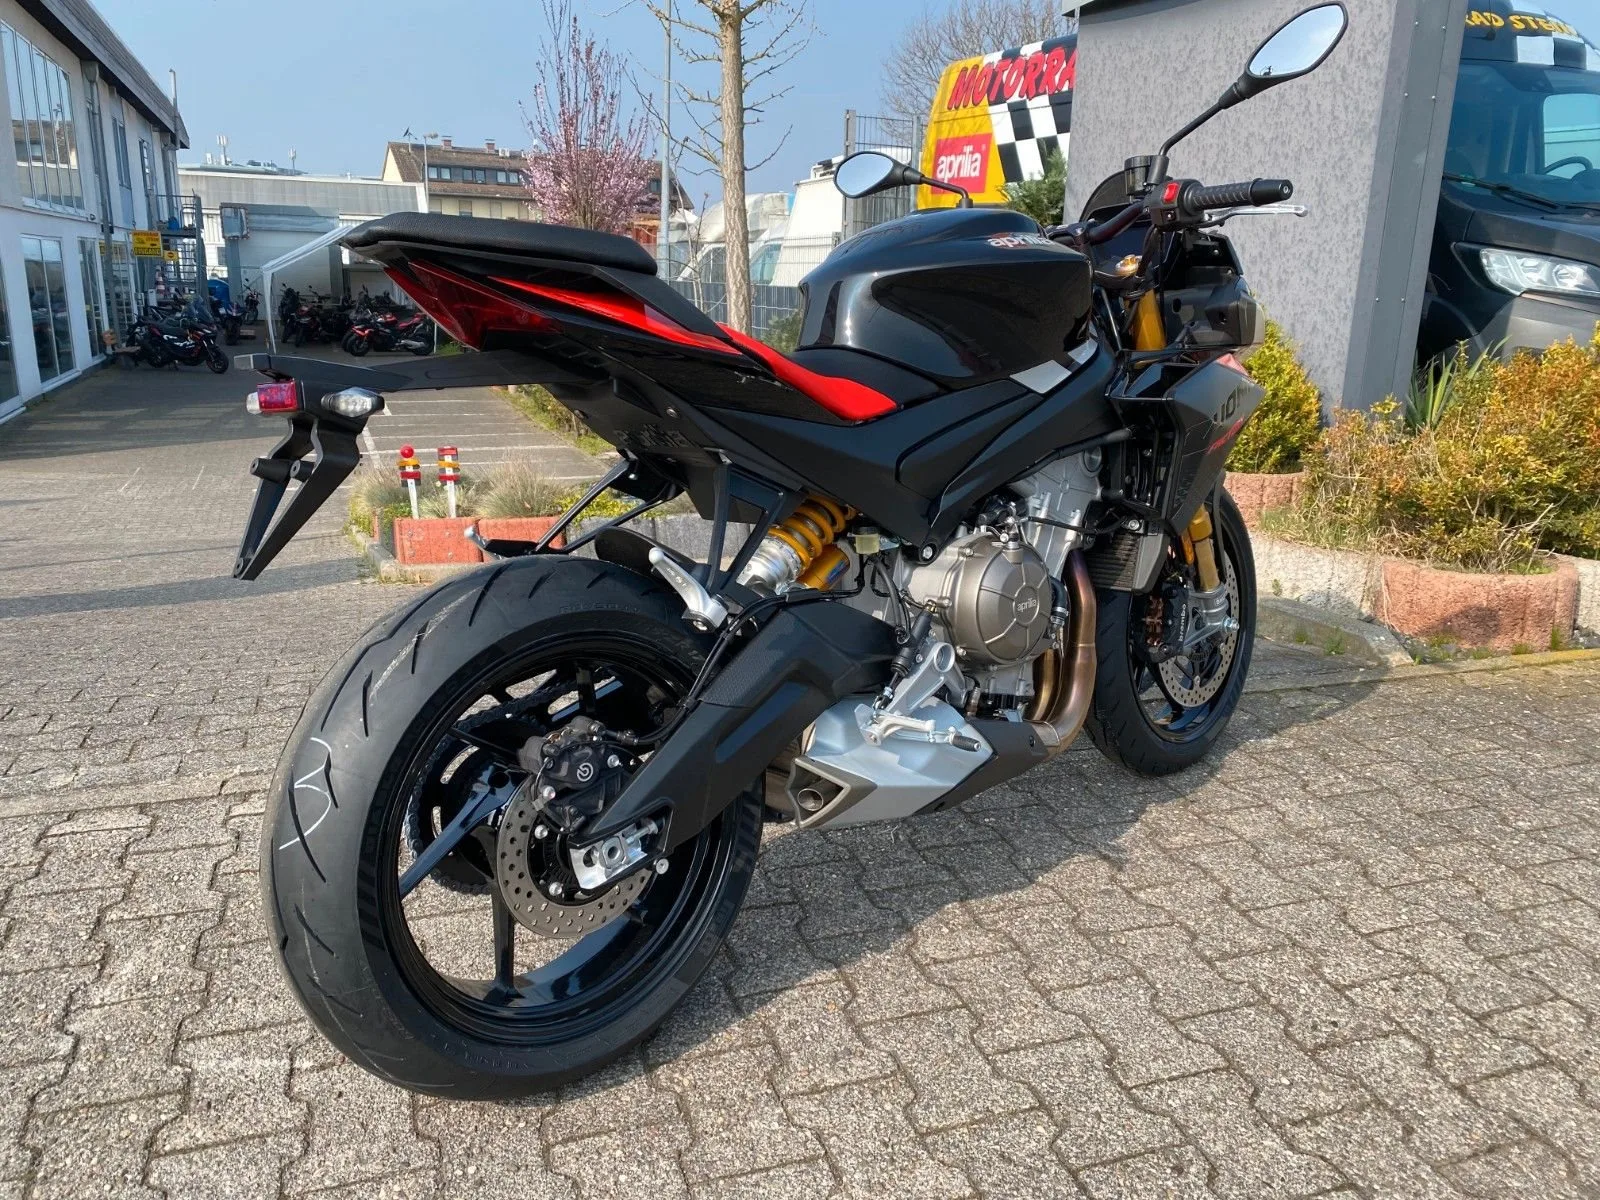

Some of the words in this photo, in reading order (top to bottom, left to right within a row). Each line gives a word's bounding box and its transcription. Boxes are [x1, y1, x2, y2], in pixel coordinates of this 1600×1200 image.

[936, 145, 981, 184] aprilia
[1017, 597, 1037, 613] aprilia
[1178, 603, 1187, 642] brembo
